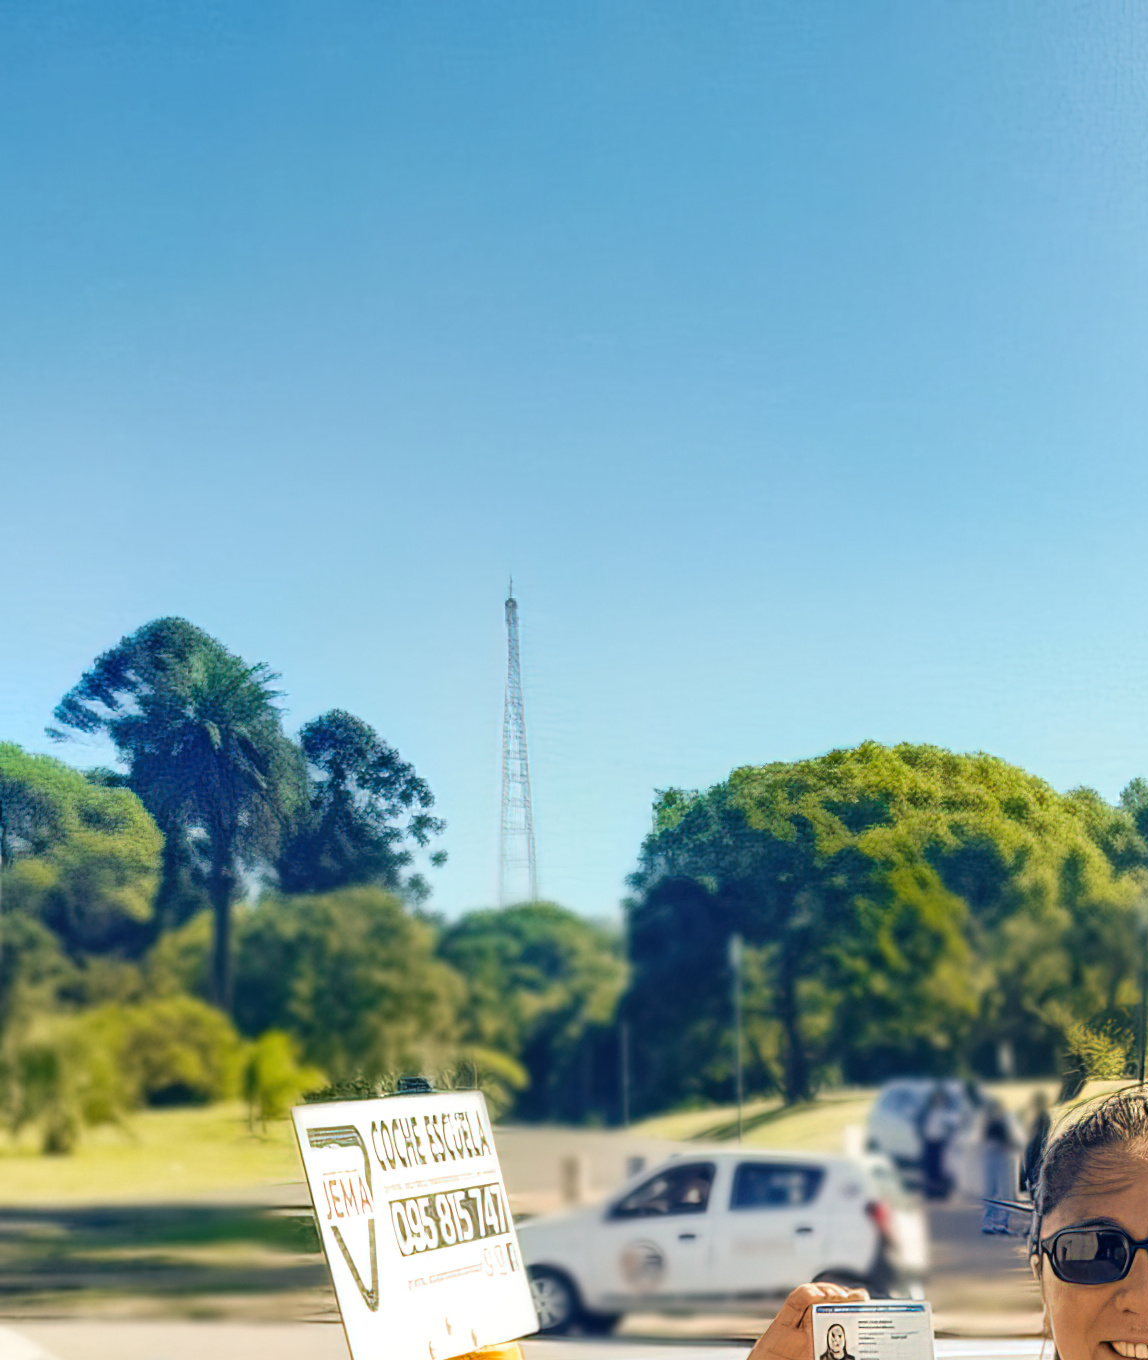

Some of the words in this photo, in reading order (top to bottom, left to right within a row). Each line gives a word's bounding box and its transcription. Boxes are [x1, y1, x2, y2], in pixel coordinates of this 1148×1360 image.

[371, 1117, 427, 1171] COCHE
[423, 1110, 491, 1162] ESCUELA
[322, 1173, 374, 1220] JEMA
[391, 1198, 438, 1255] 095
[435, 1190, 474, 1245] 815
[467, 1184, 506, 1237] 747
